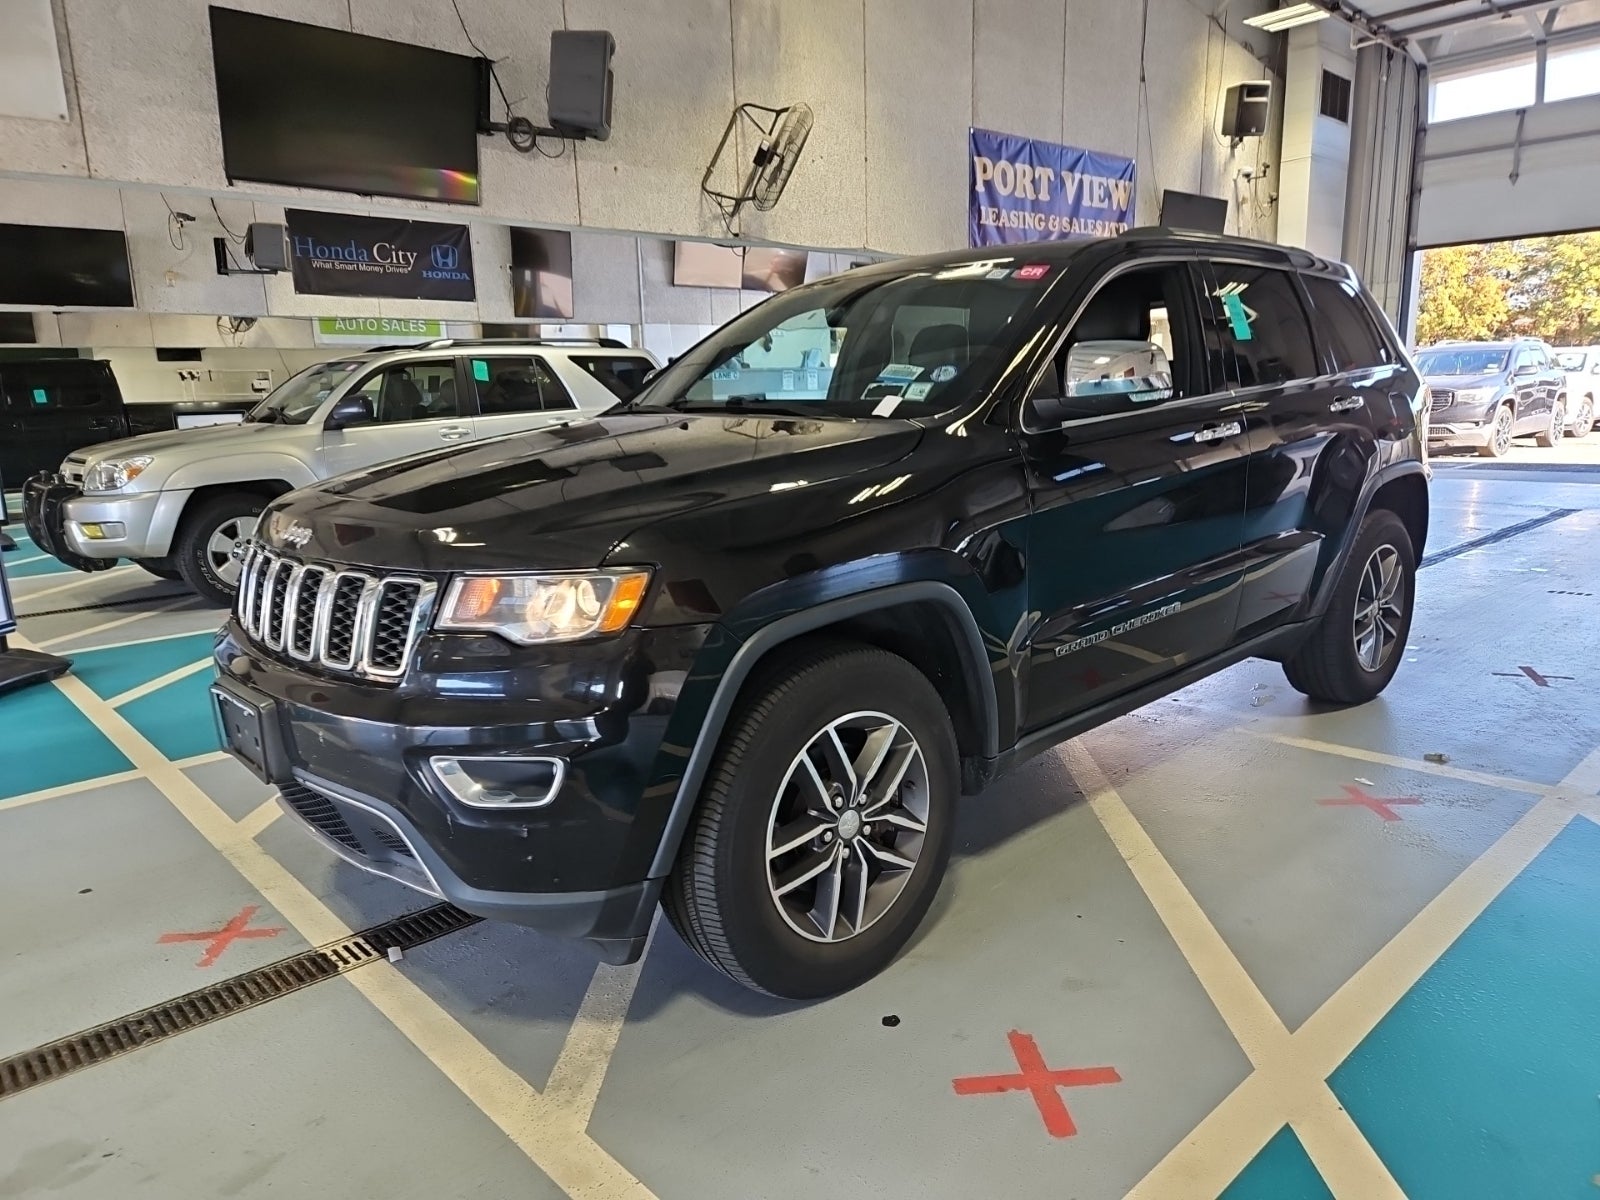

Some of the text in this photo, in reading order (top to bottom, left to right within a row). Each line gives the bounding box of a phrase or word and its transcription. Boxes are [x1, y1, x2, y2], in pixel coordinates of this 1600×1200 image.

[974, 156, 1134, 211] PORT VIEW
[980, 206, 1046, 230] LEASING
[1048, 216, 1059, 232] &
[1062, 218, 1102, 238] SALES
[293, 236, 418, 270] Honda City
[312, 261, 409, 274] What Smart Money Drives
[422, 270, 471, 281] HONDA
[335, 318, 427, 332] AUTO SALES
[1055, 601, 1182, 658] GRAND CHEROKEE
